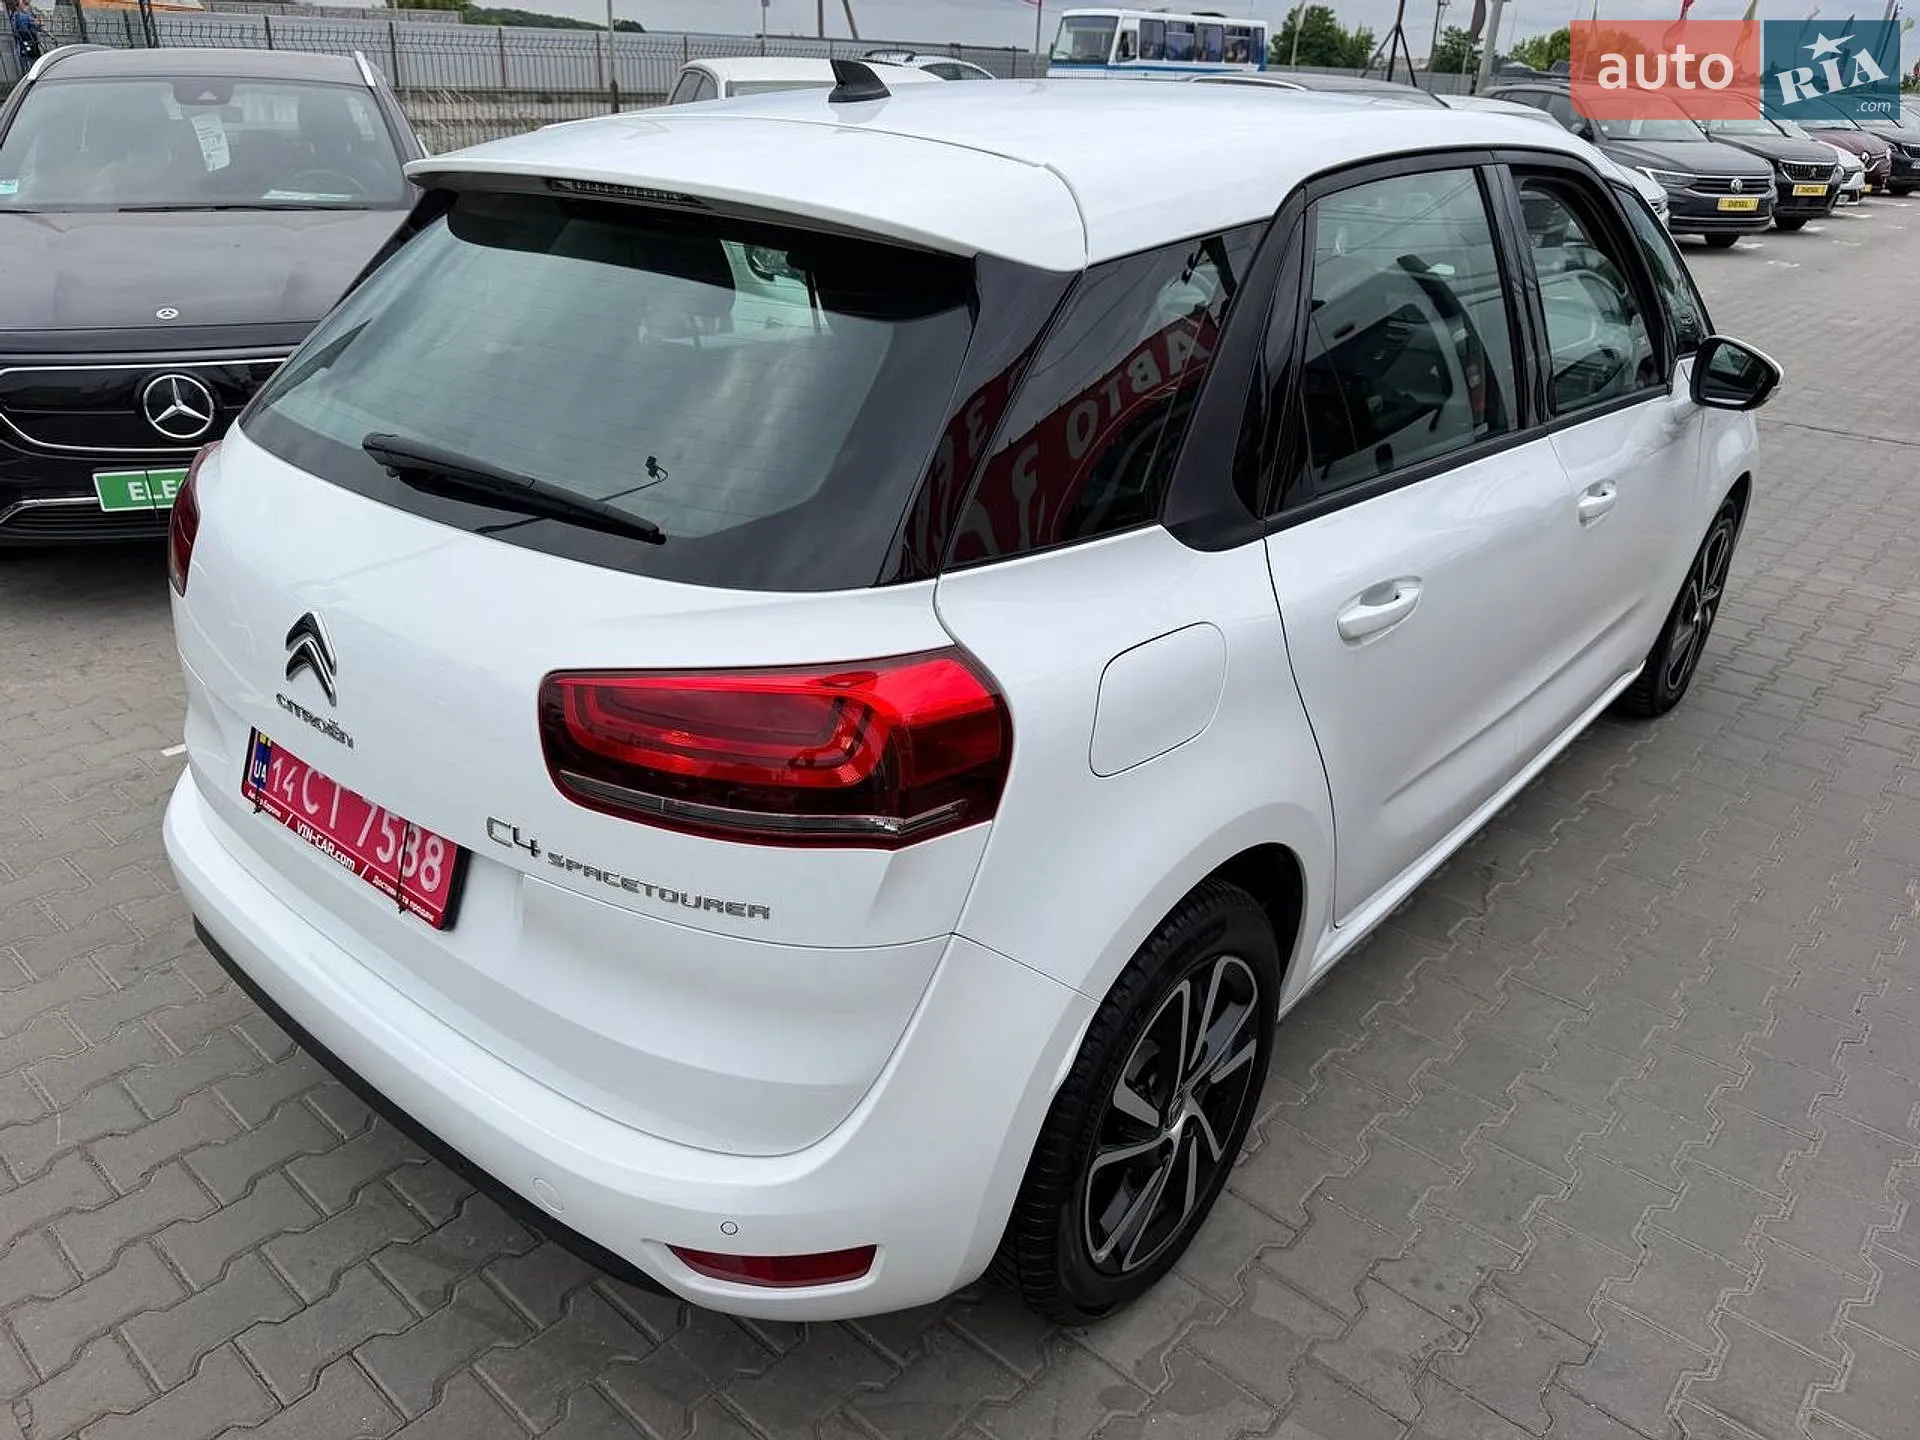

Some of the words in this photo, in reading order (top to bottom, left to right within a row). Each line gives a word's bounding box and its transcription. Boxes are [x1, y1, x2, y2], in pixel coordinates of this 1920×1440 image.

[128, 480, 184, 501] ELE
[253, 760, 267, 783] UA
[296, 820, 356, 871] VIN-CAR.com
[357, 797, 445, 893] 7588
[486, 816, 541, 857] C4
[547, 851, 771, 920] SPACETOURER
